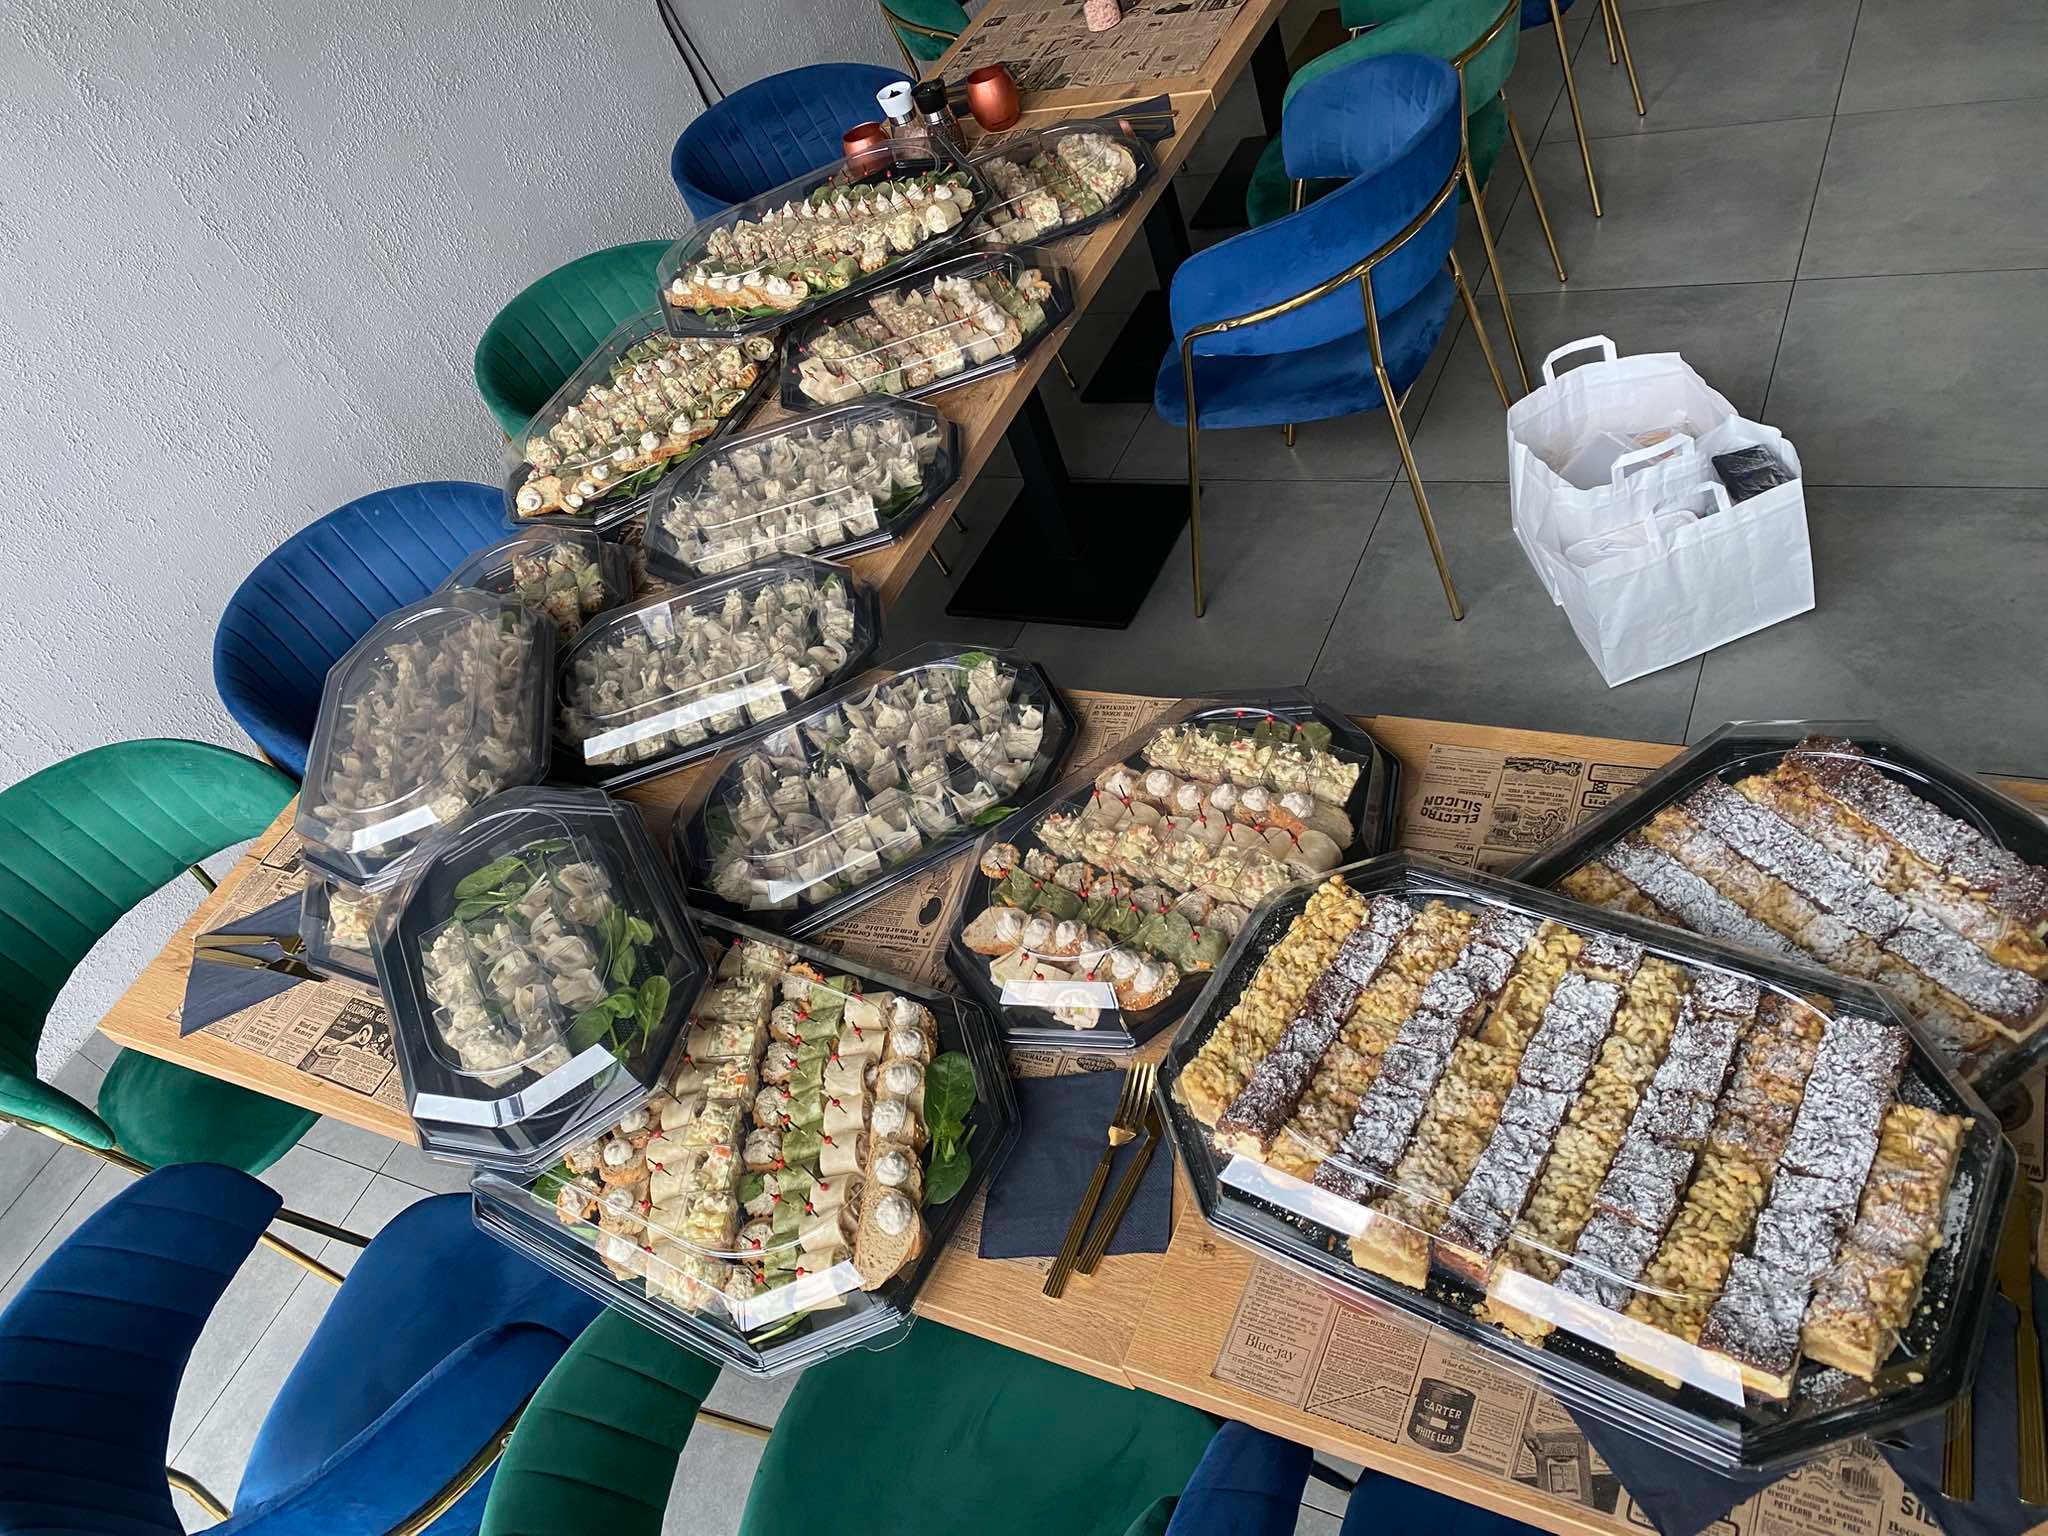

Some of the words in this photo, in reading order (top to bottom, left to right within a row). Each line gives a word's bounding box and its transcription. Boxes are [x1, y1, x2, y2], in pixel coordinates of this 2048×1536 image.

[1424, 795, 1482, 813] SILICON
[1420, 807, 1480, 824] ELECTRO
[865, 925, 920, 937] Remarkable
[872, 932, 920, 944] Remarkable
[1245, 1333, 1297, 1363] Blue-jay
[1423, 1398, 1462, 1420] CARTER
[1415, 1424, 1436, 1440] WHITE
[1436, 1433, 1455, 1446] LEAD
